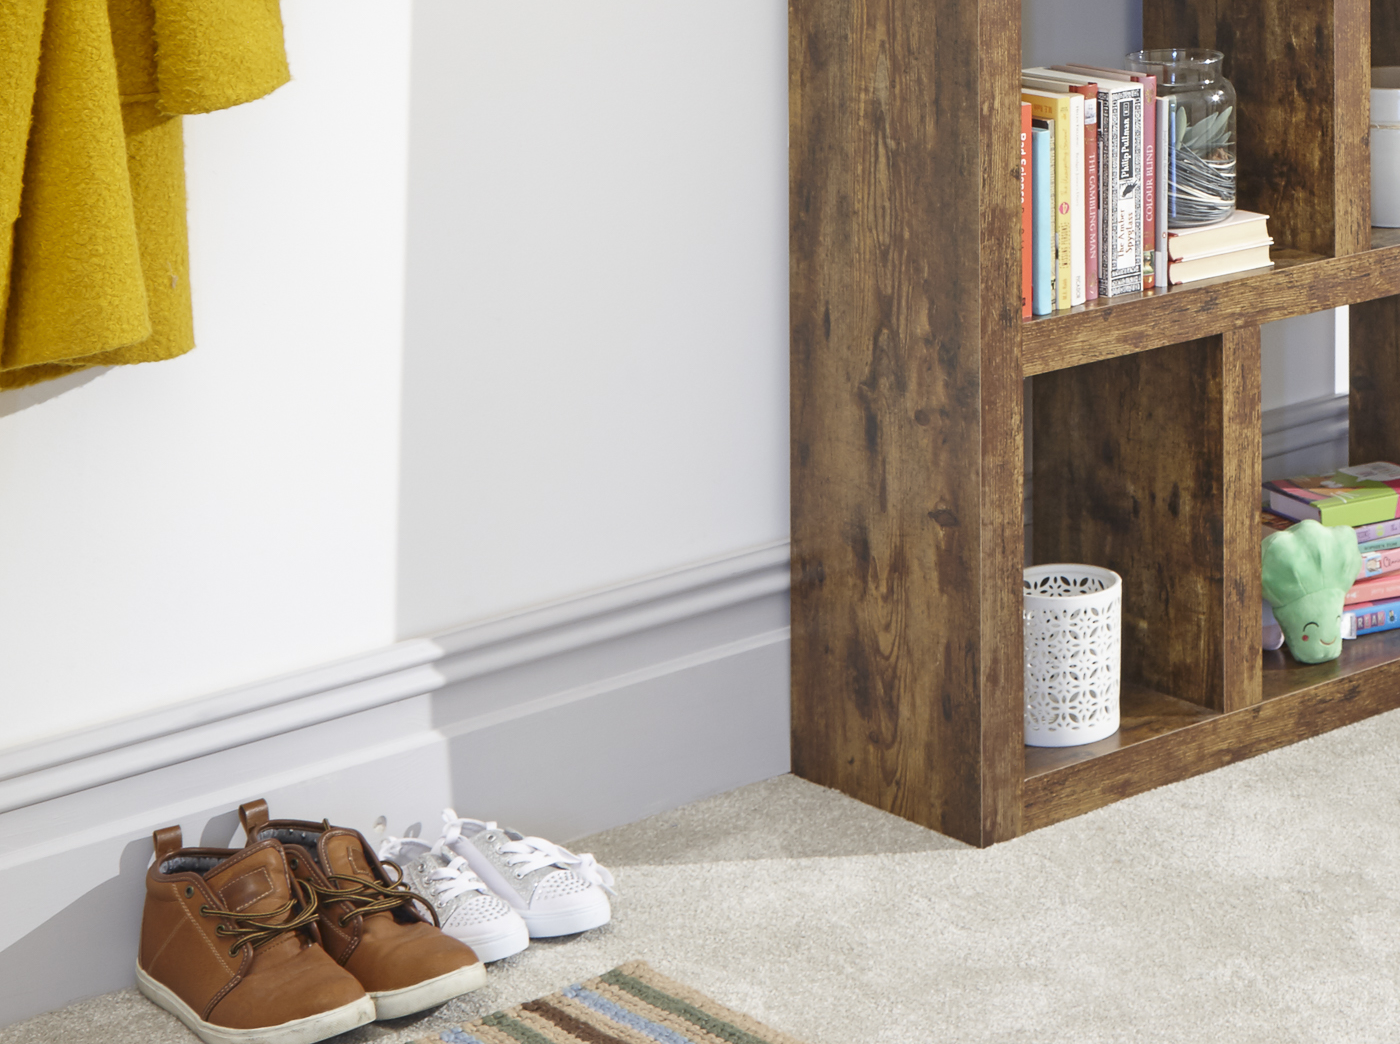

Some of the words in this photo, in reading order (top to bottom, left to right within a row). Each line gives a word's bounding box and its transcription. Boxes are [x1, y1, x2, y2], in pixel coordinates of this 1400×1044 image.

[1119, 117, 1130, 152] Pullman
[1120, 153, 1131, 178] Philip
[1145, 144, 1153, 176] BLIND
[1088, 175, 1096, 232] GAMBLING
[1145, 178, 1153, 222] COLOUR
[1118, 209, 1126, 240] Amber
[1125, 212, 1135, 254] Spyglass
[1089, 233, 1097, 259] MAN
[1357, 611, 1385, 628] REAK
